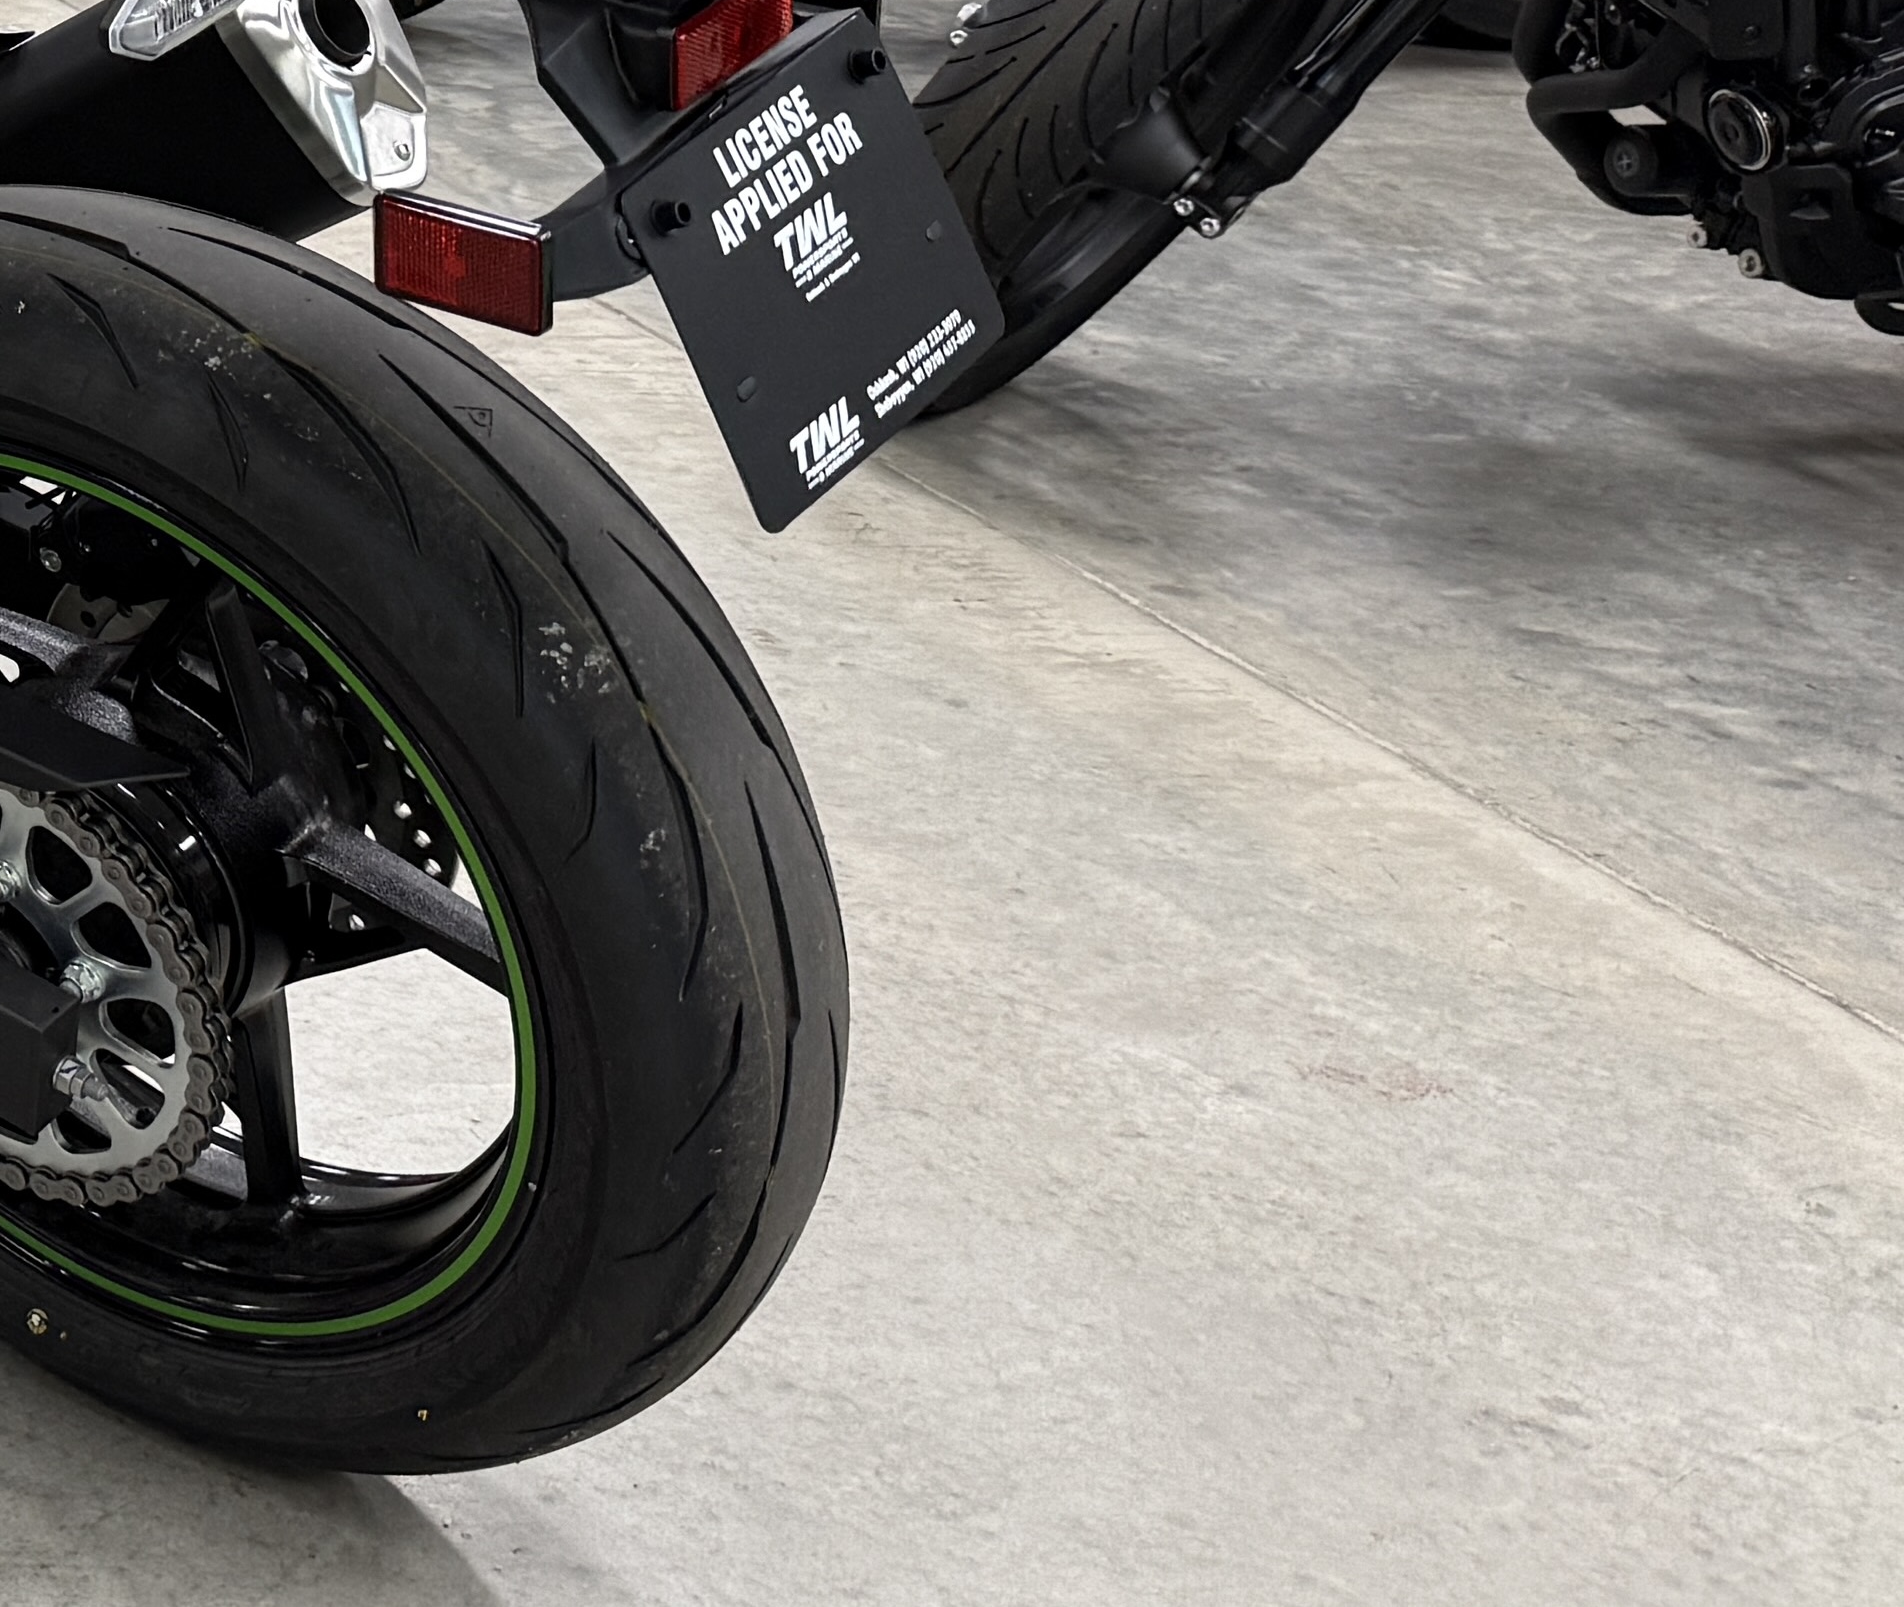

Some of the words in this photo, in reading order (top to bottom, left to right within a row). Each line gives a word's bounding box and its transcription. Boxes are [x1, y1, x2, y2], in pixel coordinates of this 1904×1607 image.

[712, 85, 818, 189] LICENSE
[711, 149, 815, 257] APPLIED
[811, 111, 864, 178] FOR
[773, 192, 849, 274] TWL
[788, 396, 861, 476] TWL
